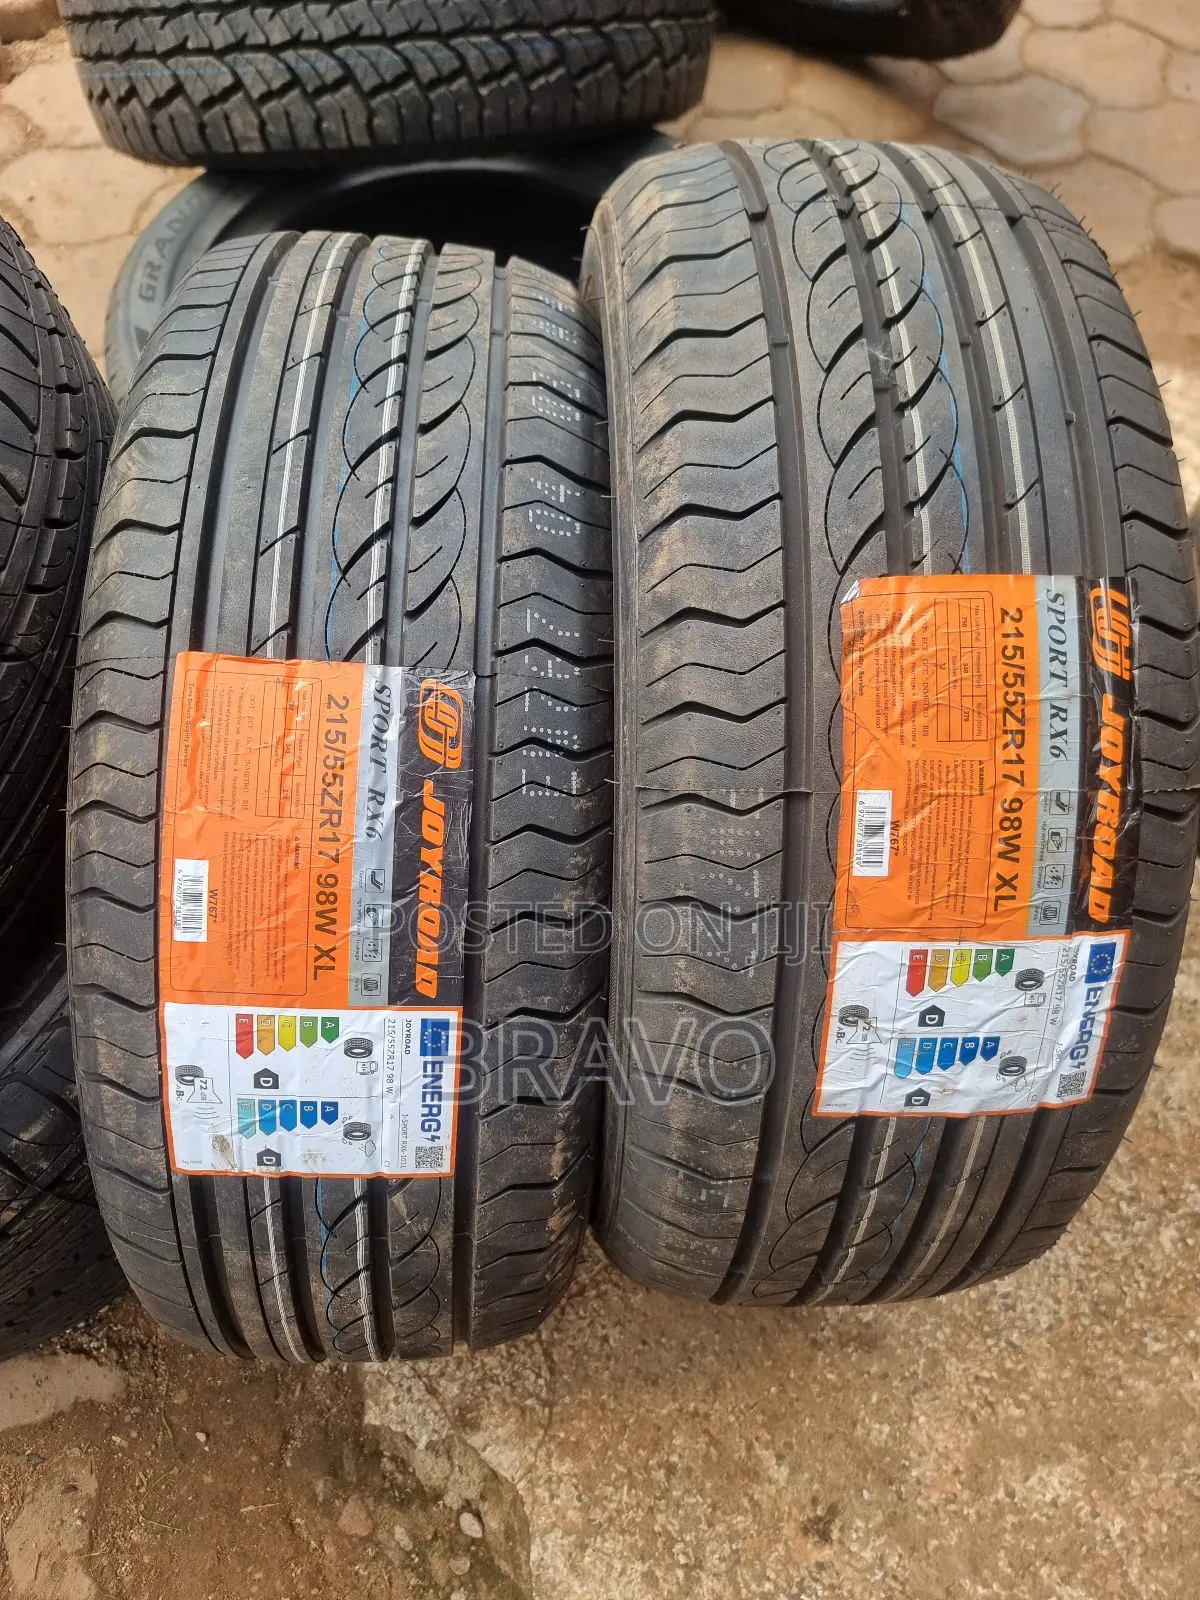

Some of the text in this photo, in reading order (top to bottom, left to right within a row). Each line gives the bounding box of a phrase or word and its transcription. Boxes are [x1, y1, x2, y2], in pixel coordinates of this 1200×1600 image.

[1045, 588, 1069, 761] SPORT RX6
[364, 680, 392, 843] SPORT RX6
[994, 608, 1025, 911] 215/55ZR17 98W XL
[1088, 694, 1124, 923] JOYROAD
[856, 809, 864, 836] 976077
[313, 694, 349, 981] 215/55ZR17 98W XL
[415, 780, 444, 999] JOYROAD
[1000, 954, 1009, 962] A
[1049, 947, 1071, 1026] 215/55ZR17 98 W
[282, 1020, 291, 1028] C
[863, 1020, 871, 1031] 72
[925, 1014, 939, 1025] D
[386, 1018, 396, 1094] 215/55ZR17 98 W
[176, 1085, 184, 1101] ABC
[200, 1079, 207, 1100] 72 dB
[260, 1077, 273, 1086] D
[421, 1060, 444, 1133] ENERG
[912, 1096, 924, 1105] D
[263, 1156, 275, 1164] D
